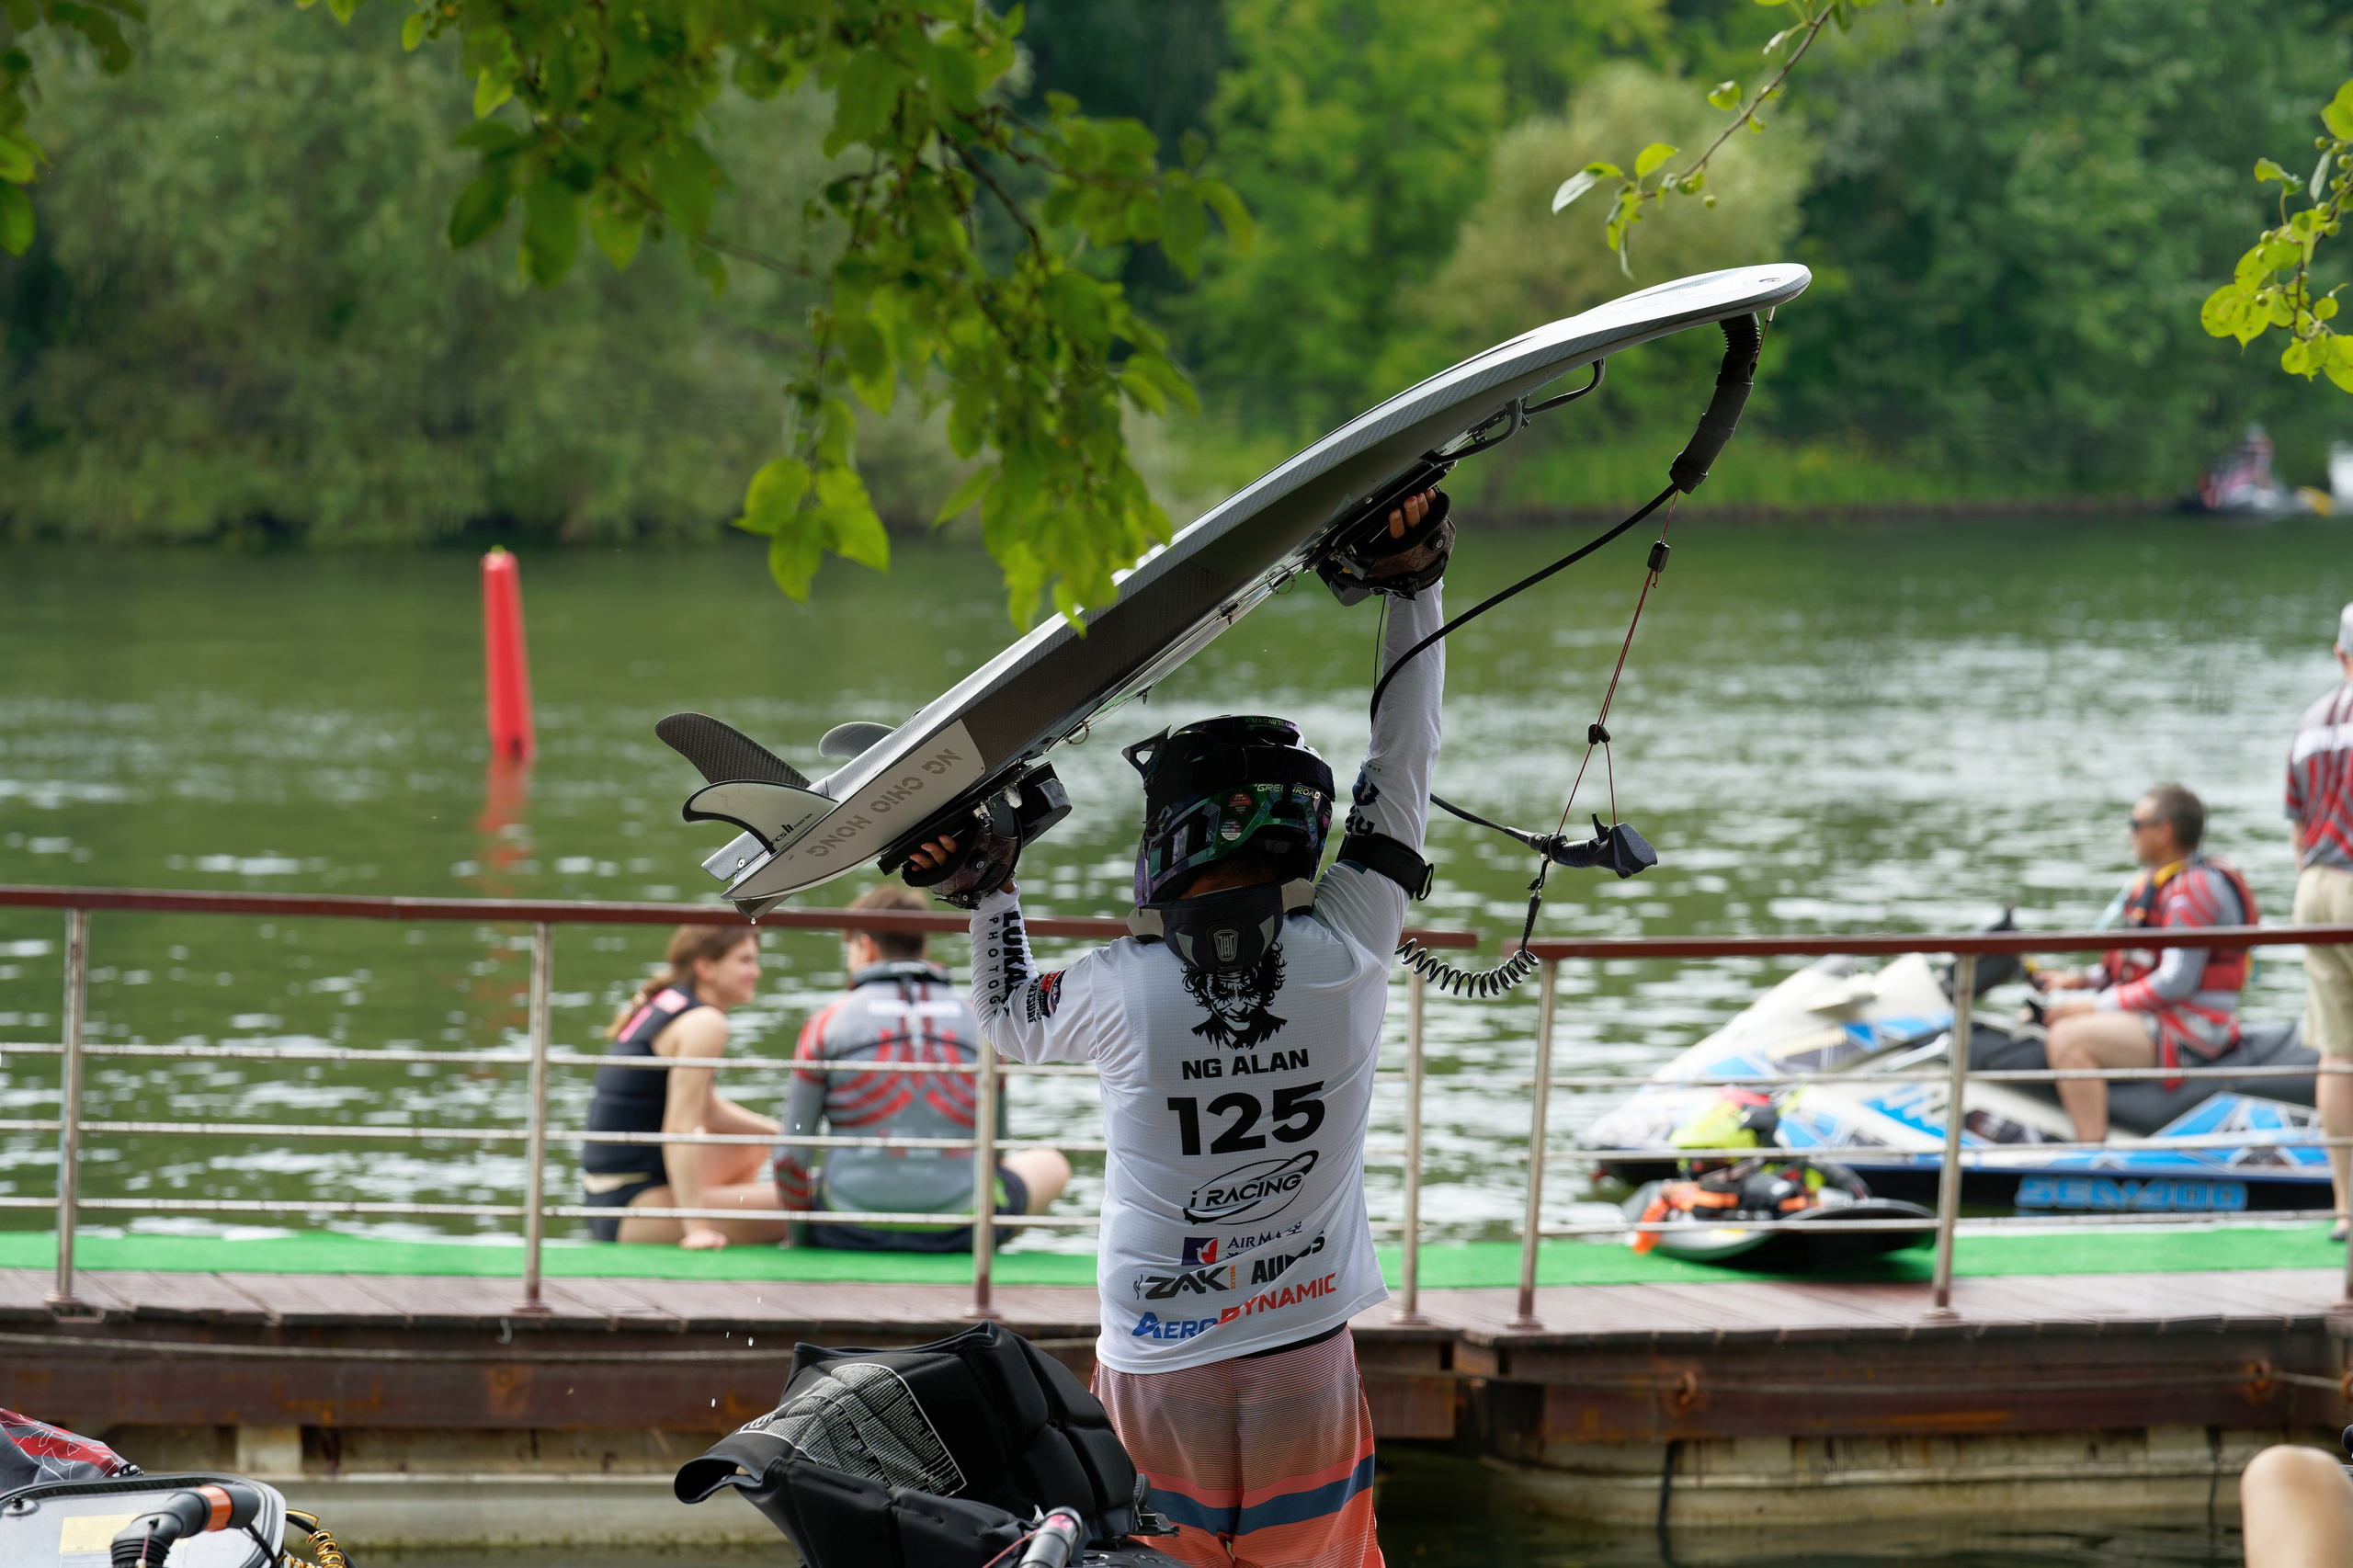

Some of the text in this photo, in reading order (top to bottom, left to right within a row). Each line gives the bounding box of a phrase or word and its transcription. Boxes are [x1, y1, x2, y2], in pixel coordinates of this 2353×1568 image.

[805, 748, 963, 858] NG CHIO HONG
[1182, 1048, 1309, 1080] NG ALAN
[1167, 1080, 1325, 1156] 125
[1206, 1174, 1302, 1207] RACING
[1145, 1266, 1230, 1300] ZAK
